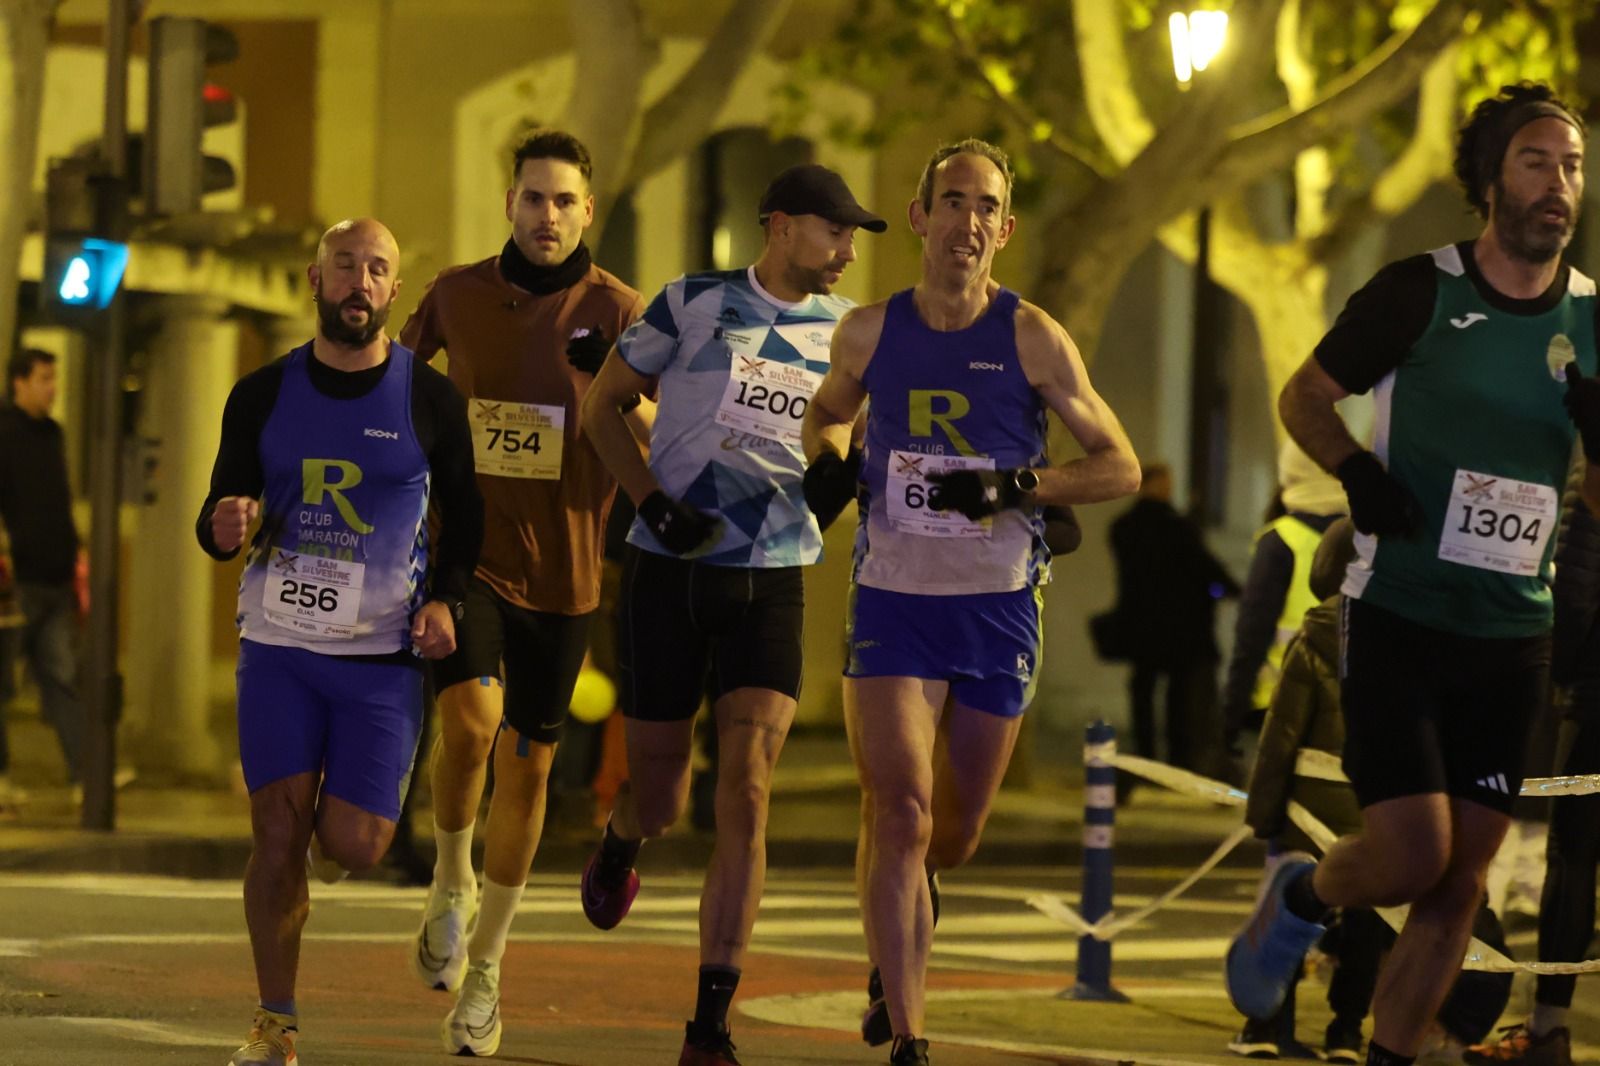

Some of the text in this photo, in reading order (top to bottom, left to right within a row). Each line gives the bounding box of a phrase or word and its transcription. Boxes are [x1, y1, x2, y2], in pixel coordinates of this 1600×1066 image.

[784, 366, 803, 378] SAN
[734, 381, 808, 420] 1200
[909, 389, 988, 458] R
[486, 428, 541, 455] 754
[303, 458, 375, 535] R
[300, 511, 333, 526] CLUB
[1458, 505, 1542, 546] 1304
[298, 529, 360, 547] MARATÓN
[302, 565, 352, 581] SILVESTRE
[317, 559, 339, 571] SAN
[280, 579, 339, 612] 256
